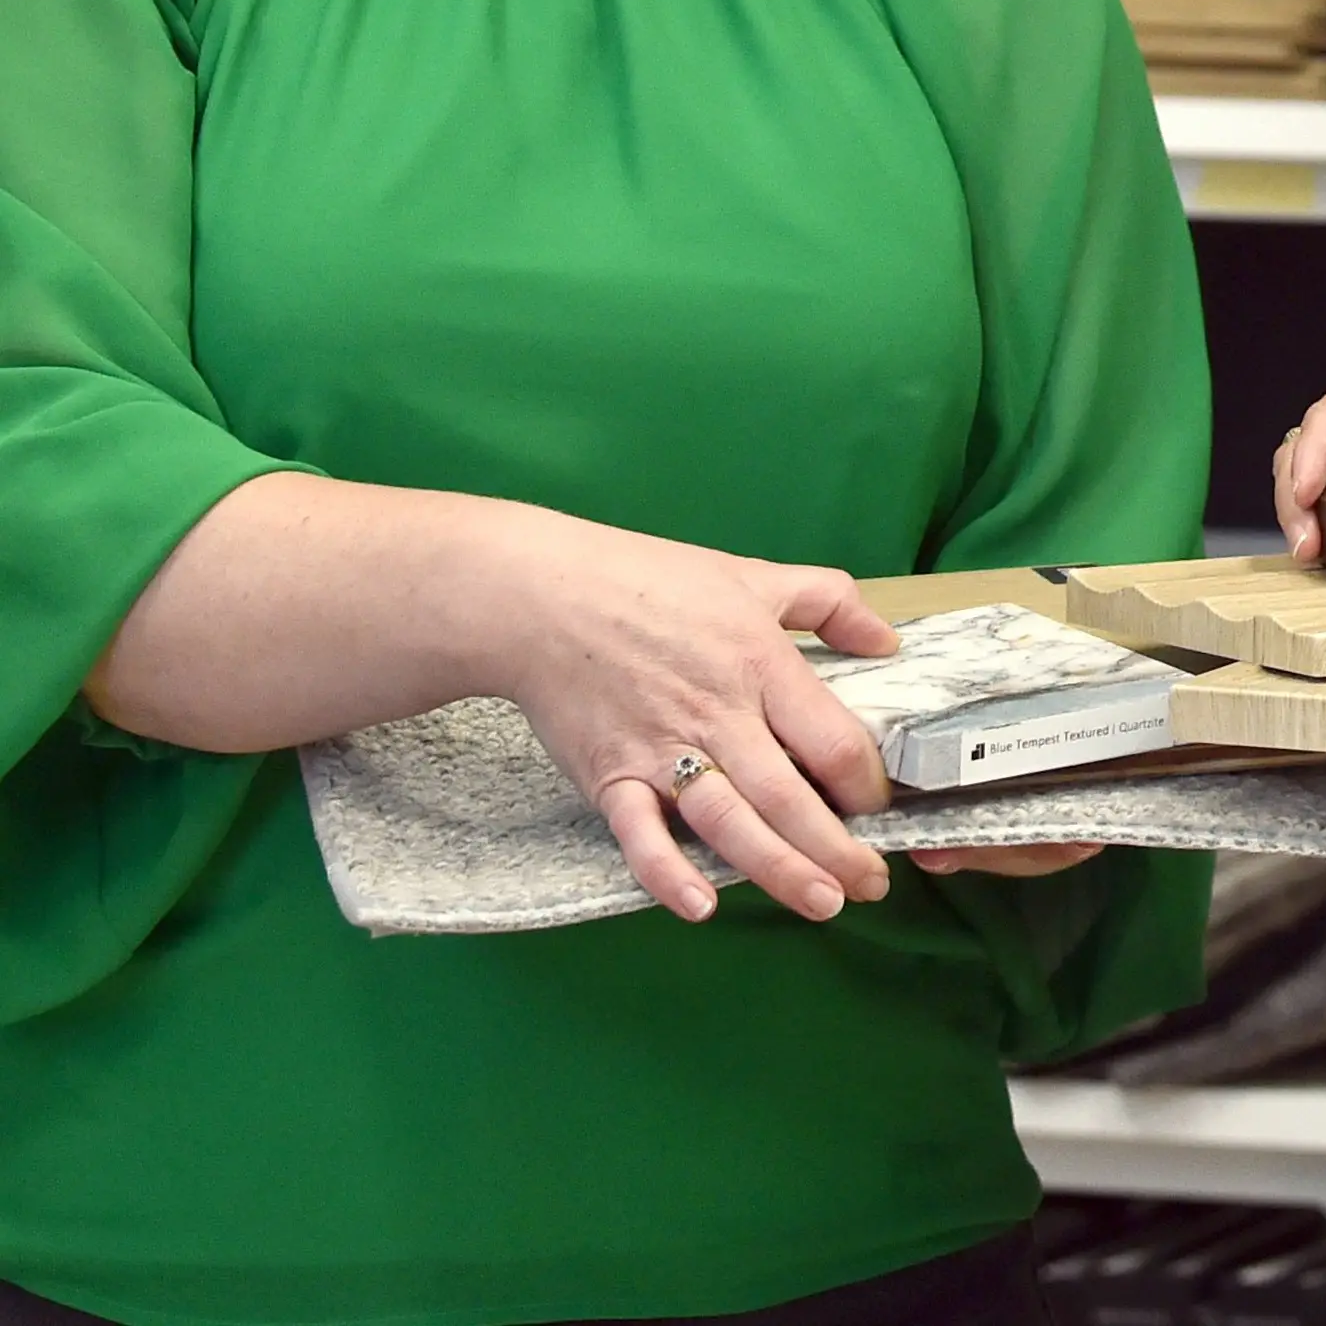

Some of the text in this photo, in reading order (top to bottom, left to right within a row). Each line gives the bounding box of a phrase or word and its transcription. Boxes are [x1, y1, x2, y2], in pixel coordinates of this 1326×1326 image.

[989, 743, 1013, 755] Blue
[1016, 734, 1060, 751] Tempest
[1063, 726, 1110, 742] Textured
[1118, 717, 1165, 734] Quartzite
